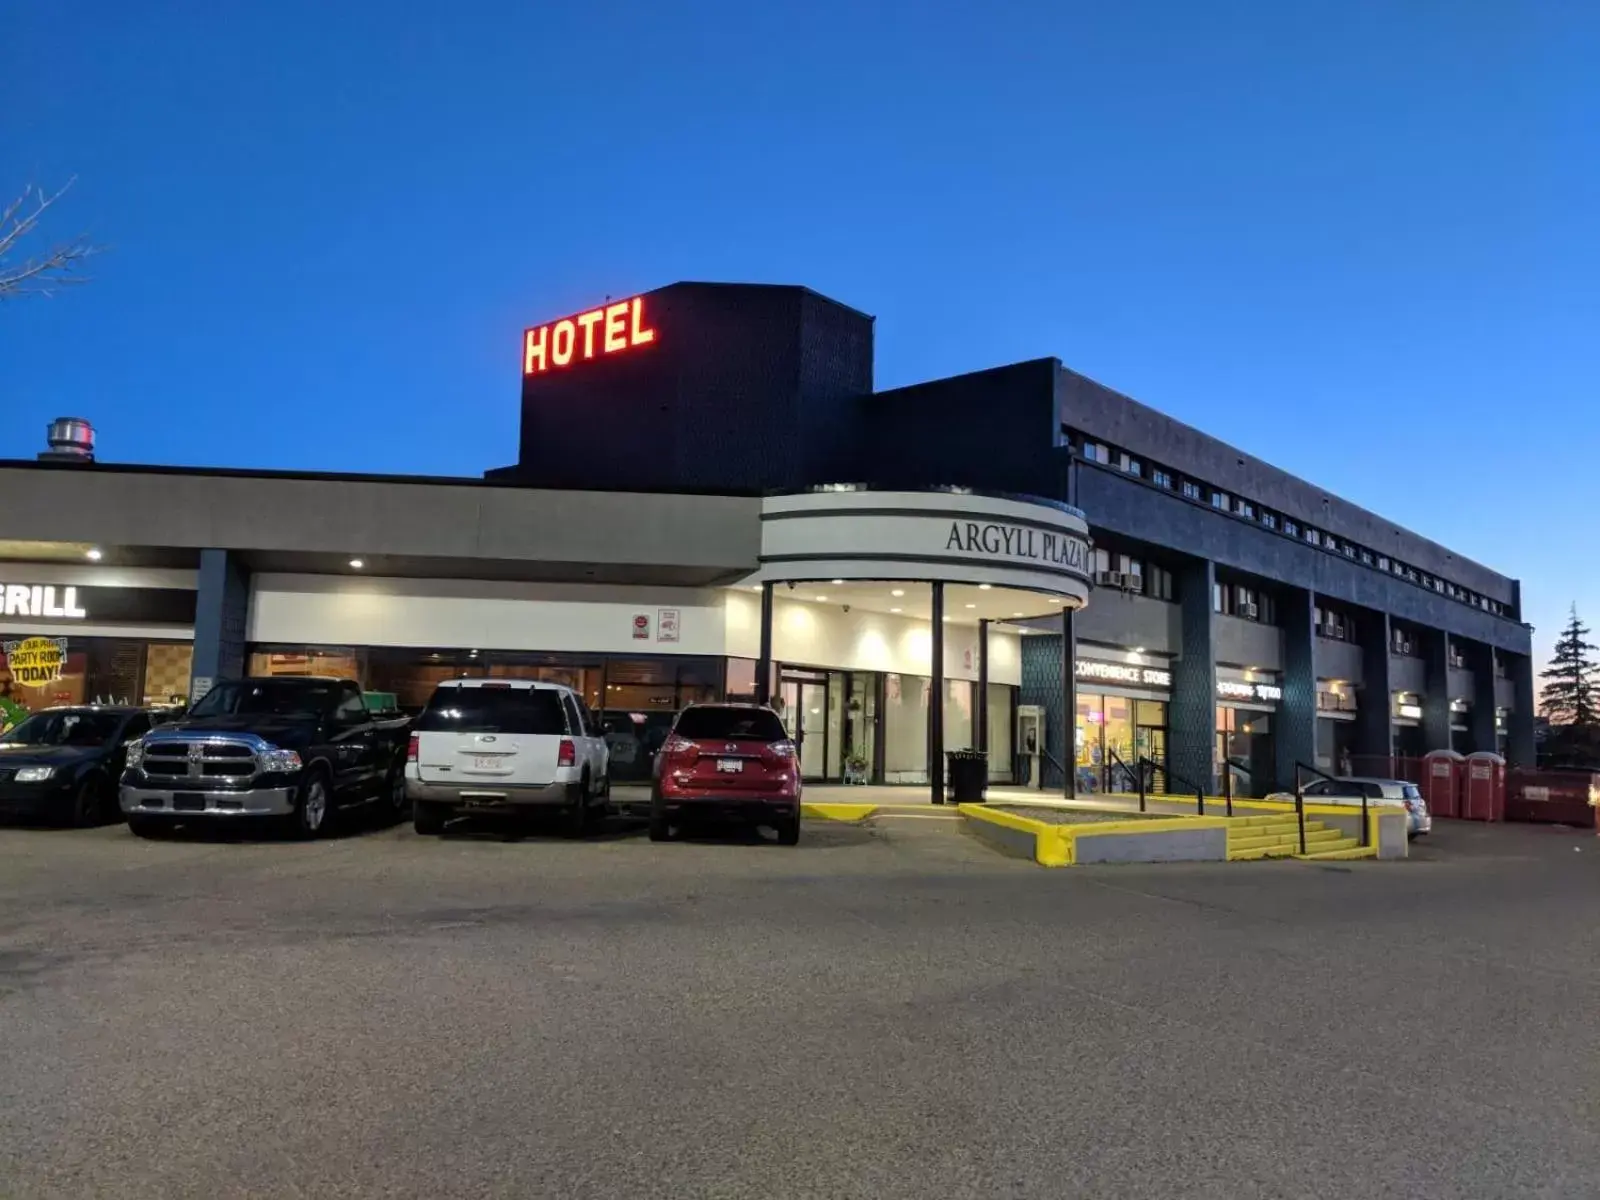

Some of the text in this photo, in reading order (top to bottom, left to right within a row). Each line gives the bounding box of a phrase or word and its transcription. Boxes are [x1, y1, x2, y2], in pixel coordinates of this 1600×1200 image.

[524, 297, 654, 374] HOTEL
[946, 521, 1037, 559] ARGYLL
[1042, 532, 1082, 569] PLAZA
[0, 584, 86, 618] RILL
[10, 652, 37, 664] PARTY
[13, 665, 59, 680] TODAY!
[1143, 669, 1171, 685] STORE
